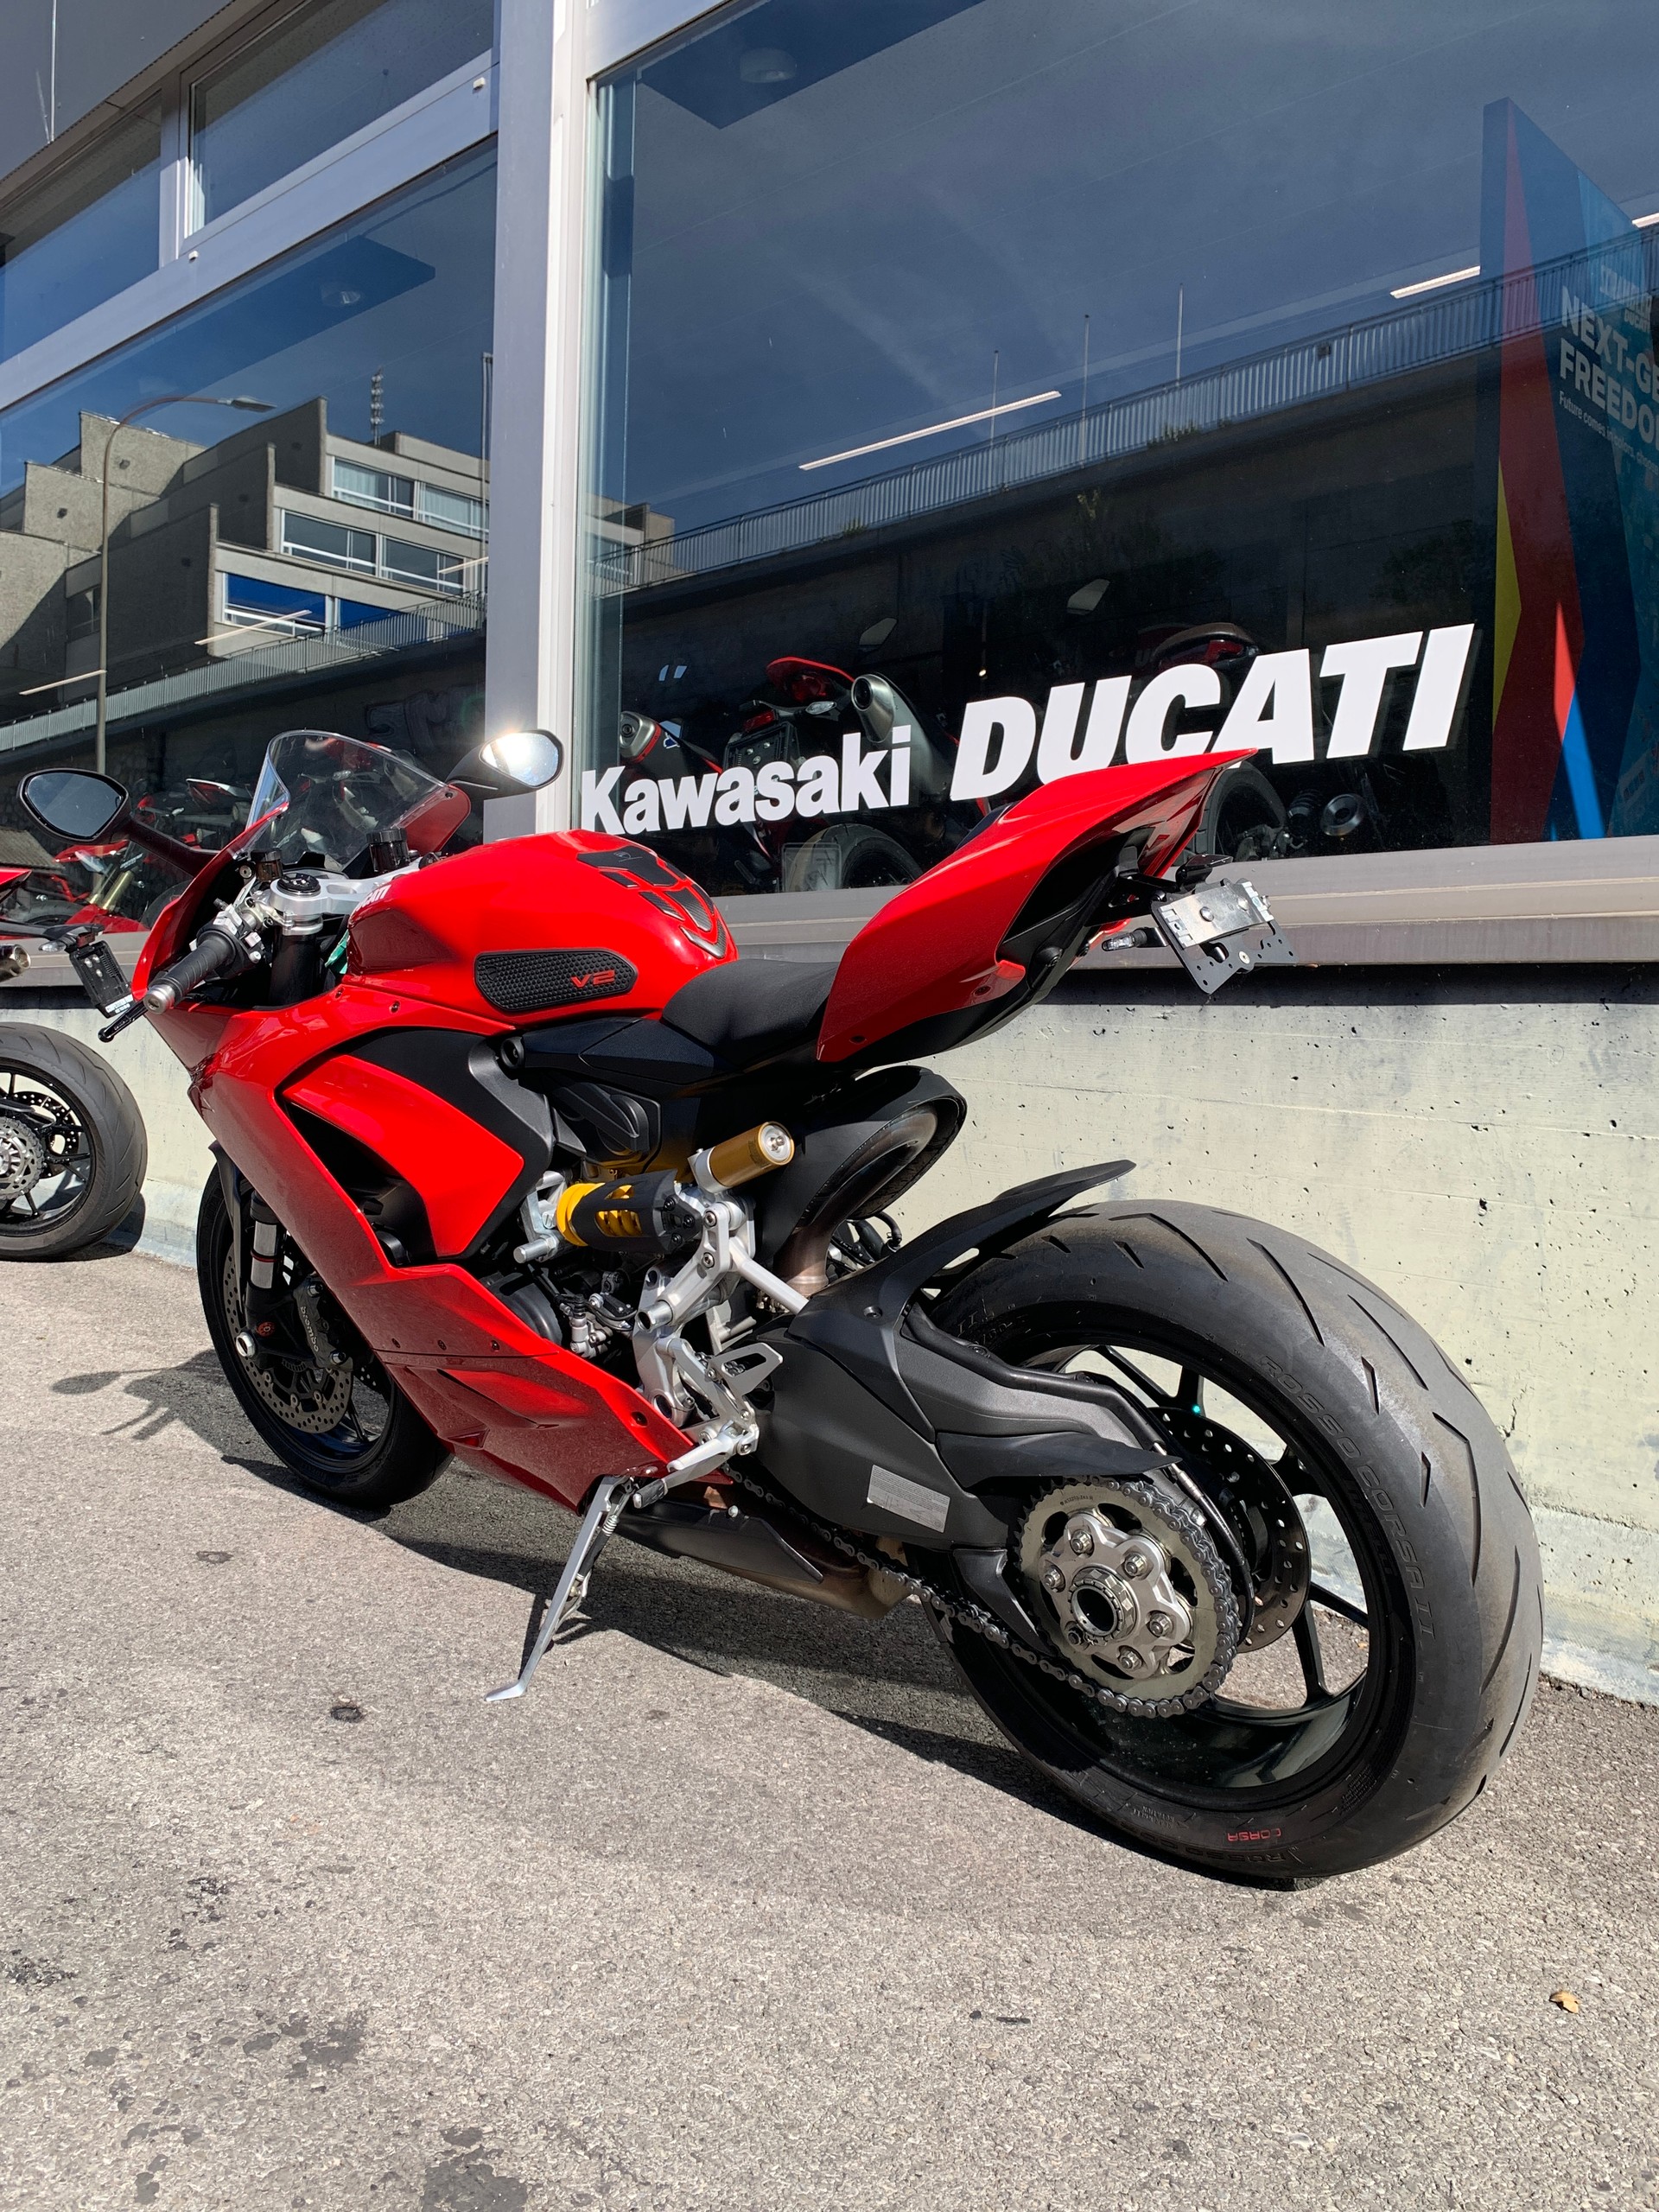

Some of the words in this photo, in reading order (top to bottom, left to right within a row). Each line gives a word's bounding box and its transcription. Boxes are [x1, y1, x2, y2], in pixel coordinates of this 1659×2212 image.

[1559, 337, 1659, 451] FREEDO
[1559, 390, 1583, 420] Future
[1583, 412, 1606, 437] comes
[950, 623, 1474, 801] DUCATI
[582, 724, 912, 835] Kawasaki
[570, 969, 615, 988] V2
[1259, 1355, 1362, 1459] ROSSO
[1357, 1464, 1425, 1589] CORSA
[1227, 1827, 1281, 1842] CORSA
